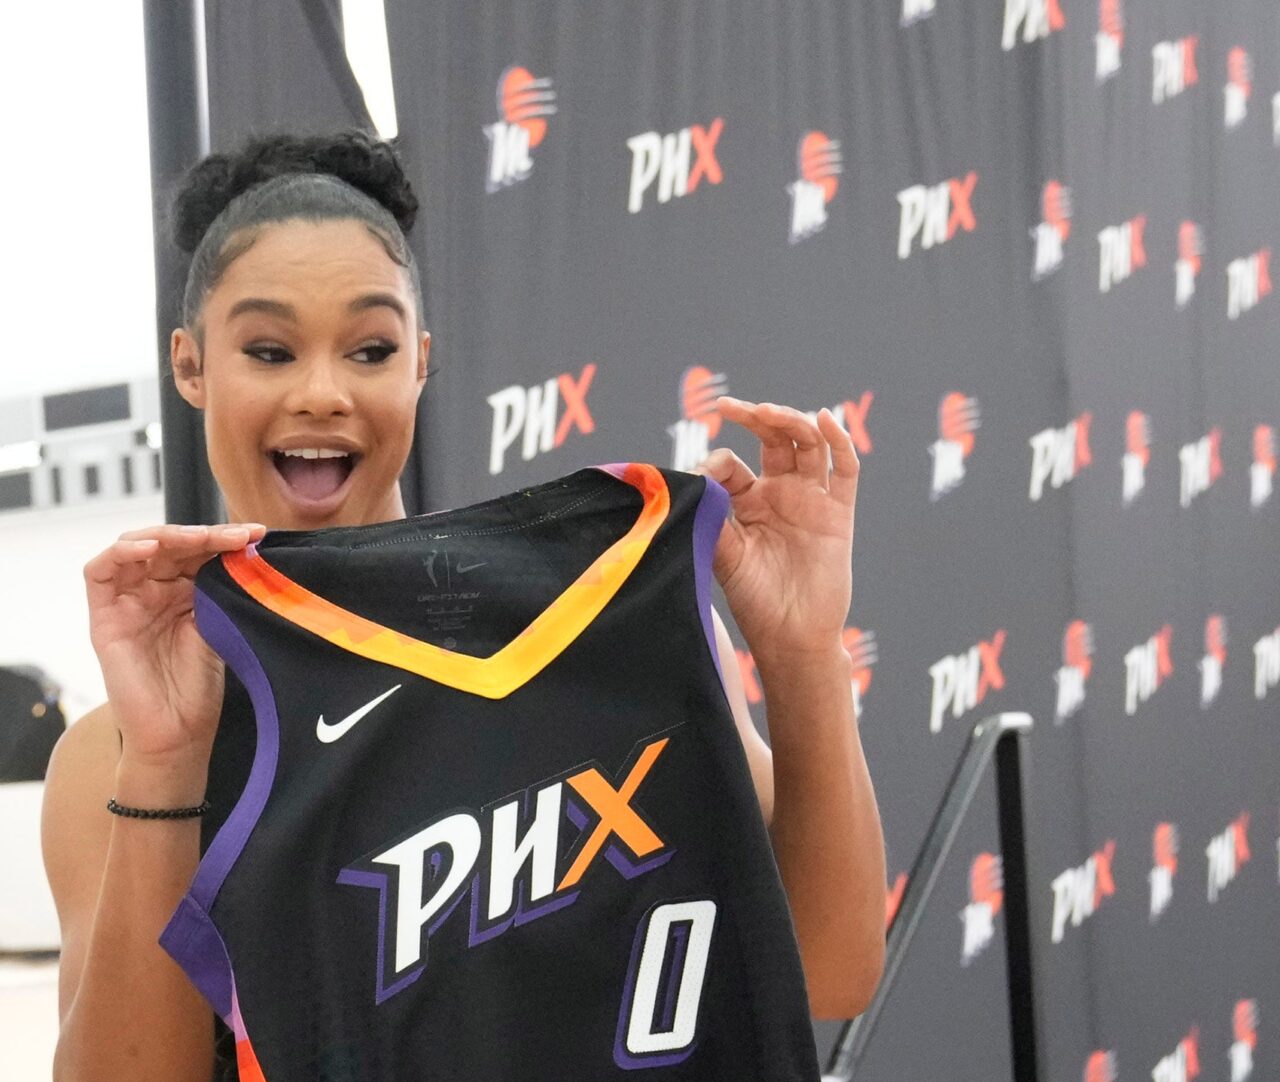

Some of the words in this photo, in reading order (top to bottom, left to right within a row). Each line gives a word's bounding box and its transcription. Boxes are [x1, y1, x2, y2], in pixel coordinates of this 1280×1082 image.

[627, 116, 725, 214] PHX
[897, 171, 979, 259] PHX
[1097, 213, 1148, 293] PHX
[487, 363, 597, 475] PHX
[1029, 411, 1094, 501] PHX
[929, 629, 1008, 734] PHX
[1124, 625, 1174, 716] PHX
[370, 737, 672, 976] PHX
[1051, 839, 1116, 944] PHX
[624, 899, 718, 1058] 0
